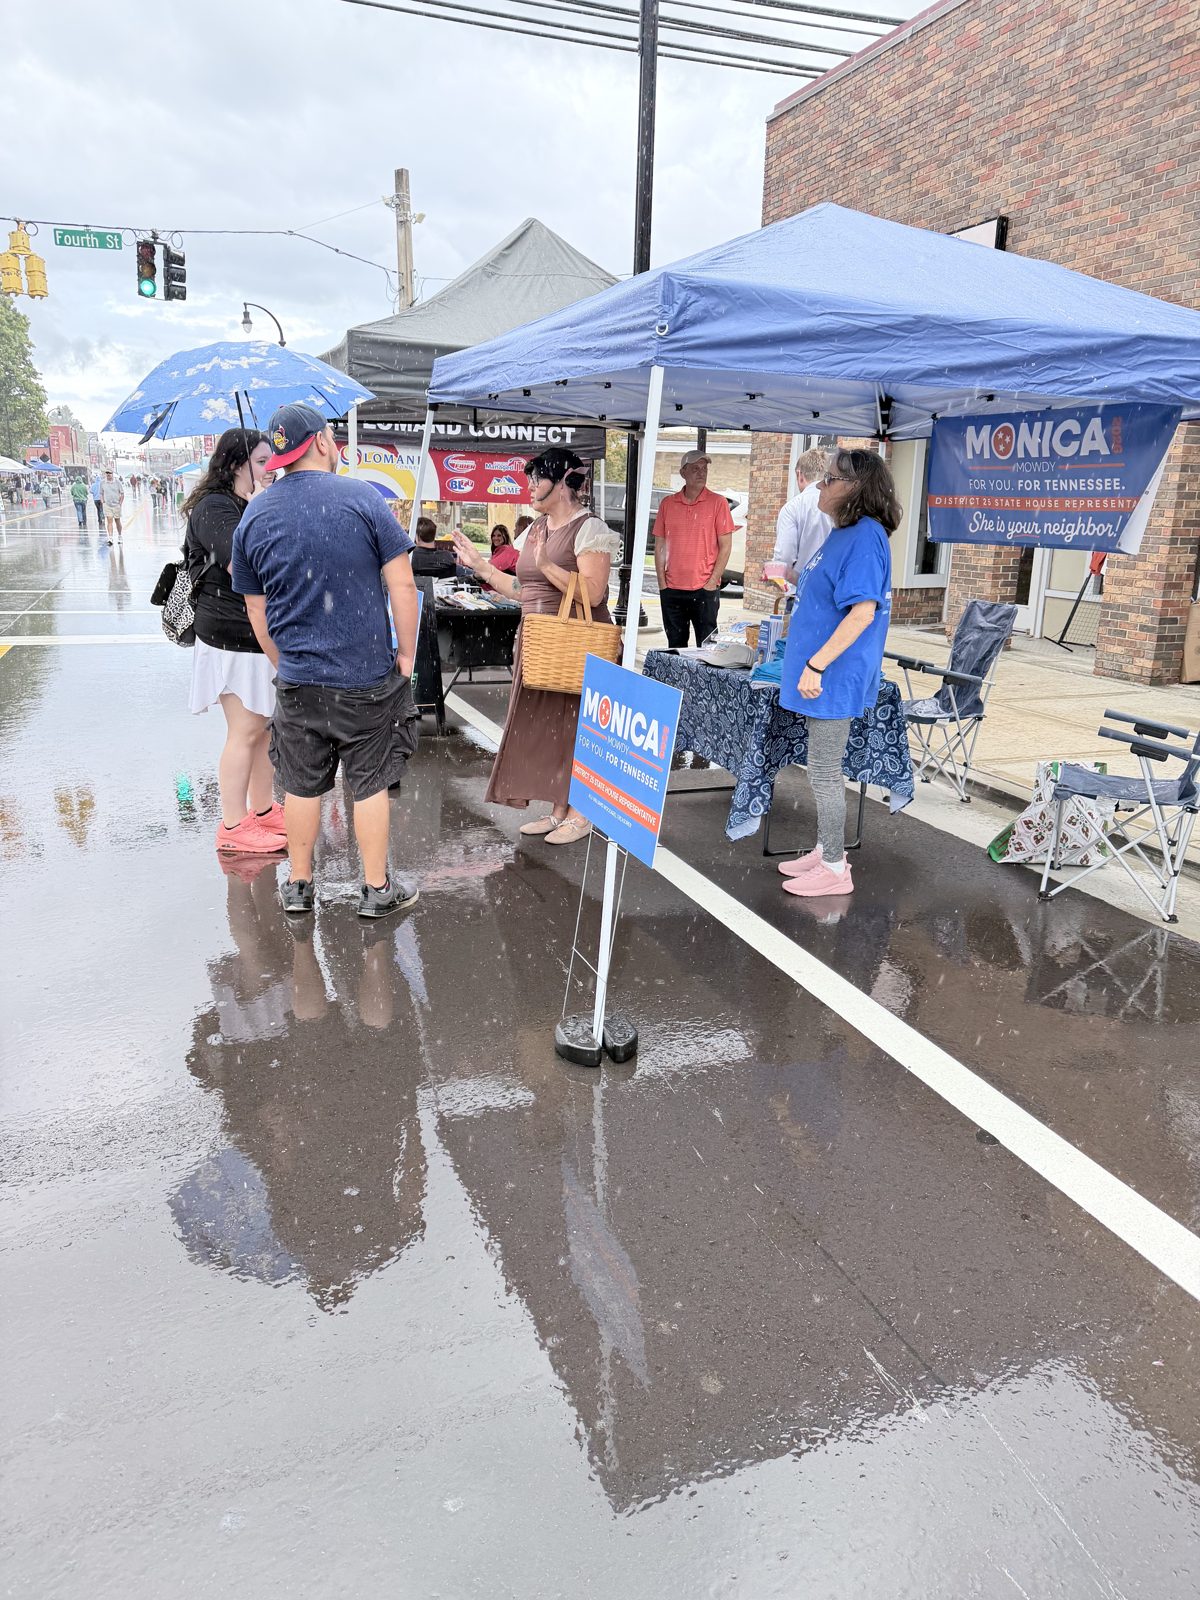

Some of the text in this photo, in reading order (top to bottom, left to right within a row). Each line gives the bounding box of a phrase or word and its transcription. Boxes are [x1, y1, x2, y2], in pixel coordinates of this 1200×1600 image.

[55, 230, 120, 249] Fourth St
[468, 425, 576, 444] CONNECT
[966, 417, 1110, 460] MONICA
[1016, 461, 1056, 473] MOWDY
[493, 486, 521, 494] HOME
[969, 477, 1126, 492] FOR YOU. FOR TENNESSEE.
[935, 497, 980, 506] DISTRICT
[983, 498, 992, 506] 25
[994, 499, 1021, 507] STATE
[1025, 499, 1059, 508] HOUSE
[969, 511, 1122, 542] She is your neighbor!
[582, 687, 660, 757] MONICA
[606, 736, 630, 755] MOWDY
[578, 734, 660, 792] FOR YOU. FOR TENNESSEE.
[605, 785, 619, 802] HOUSE
[619, 795, 657, 826] REPRESENTATIVE
